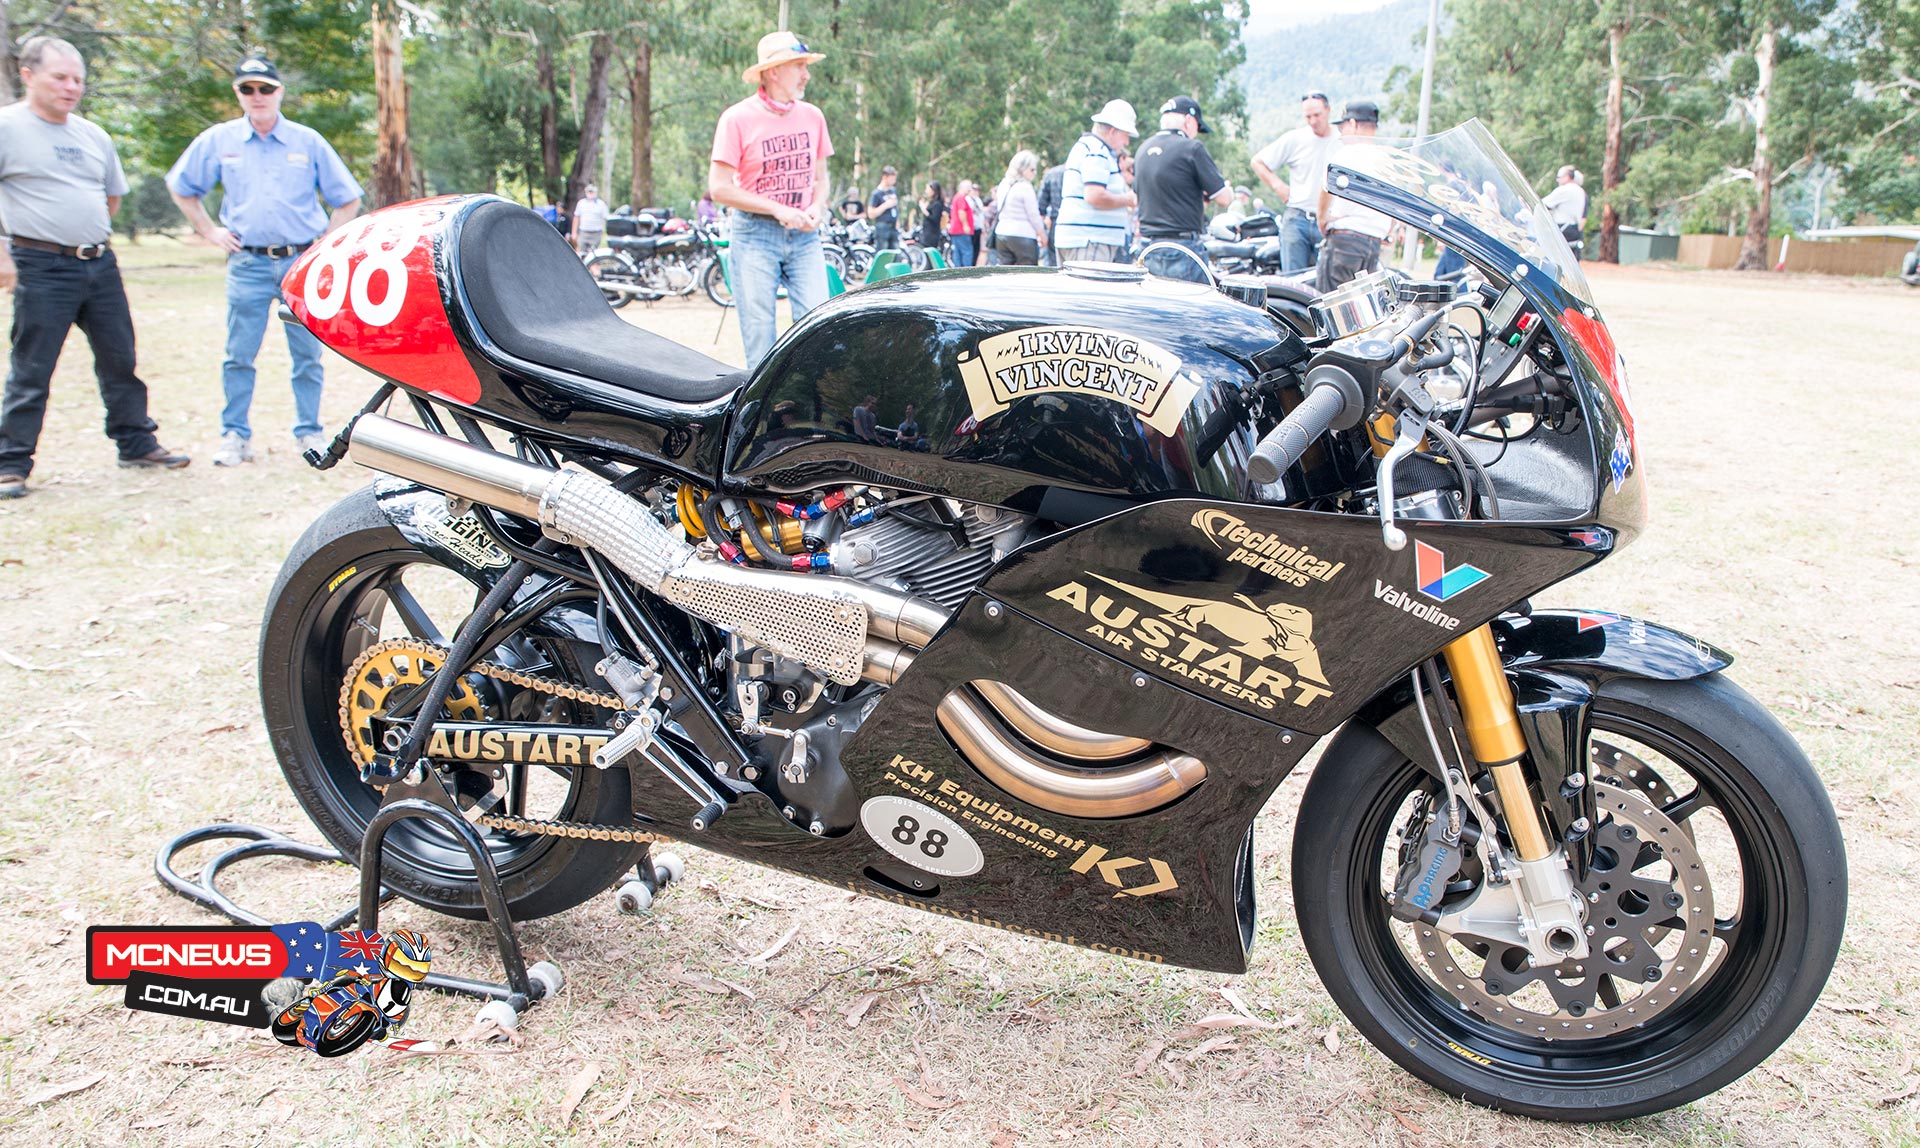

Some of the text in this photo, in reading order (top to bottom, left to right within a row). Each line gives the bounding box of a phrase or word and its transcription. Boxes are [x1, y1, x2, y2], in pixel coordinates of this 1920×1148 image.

[303, 213, 420, 327] 88
[1019, 331, 1139, 364] IRVING
[996, 358, 1158, 405] VINCENT
[446, 534, 485, 564] Heads
[1203, 509, 1346, 582] Technical
[1226, 547, 1310, 587] partners
[1374, 579, 1460, 631] Valvoline
[1045, 581, 1334, 708] AUSTART
[1085, 624, 1277, 709] AIR STARTERS
[427, 729, 609, 765] AUSTART
[883, 771, 1059, 859] Precision Engineering
[889, 754, 1088, 852] KH Equipment
[916, 803, 969, 840] GOODWOOD
[891, 815, 949, 858] 88
[1423, 847, 1448, 885] RACING
